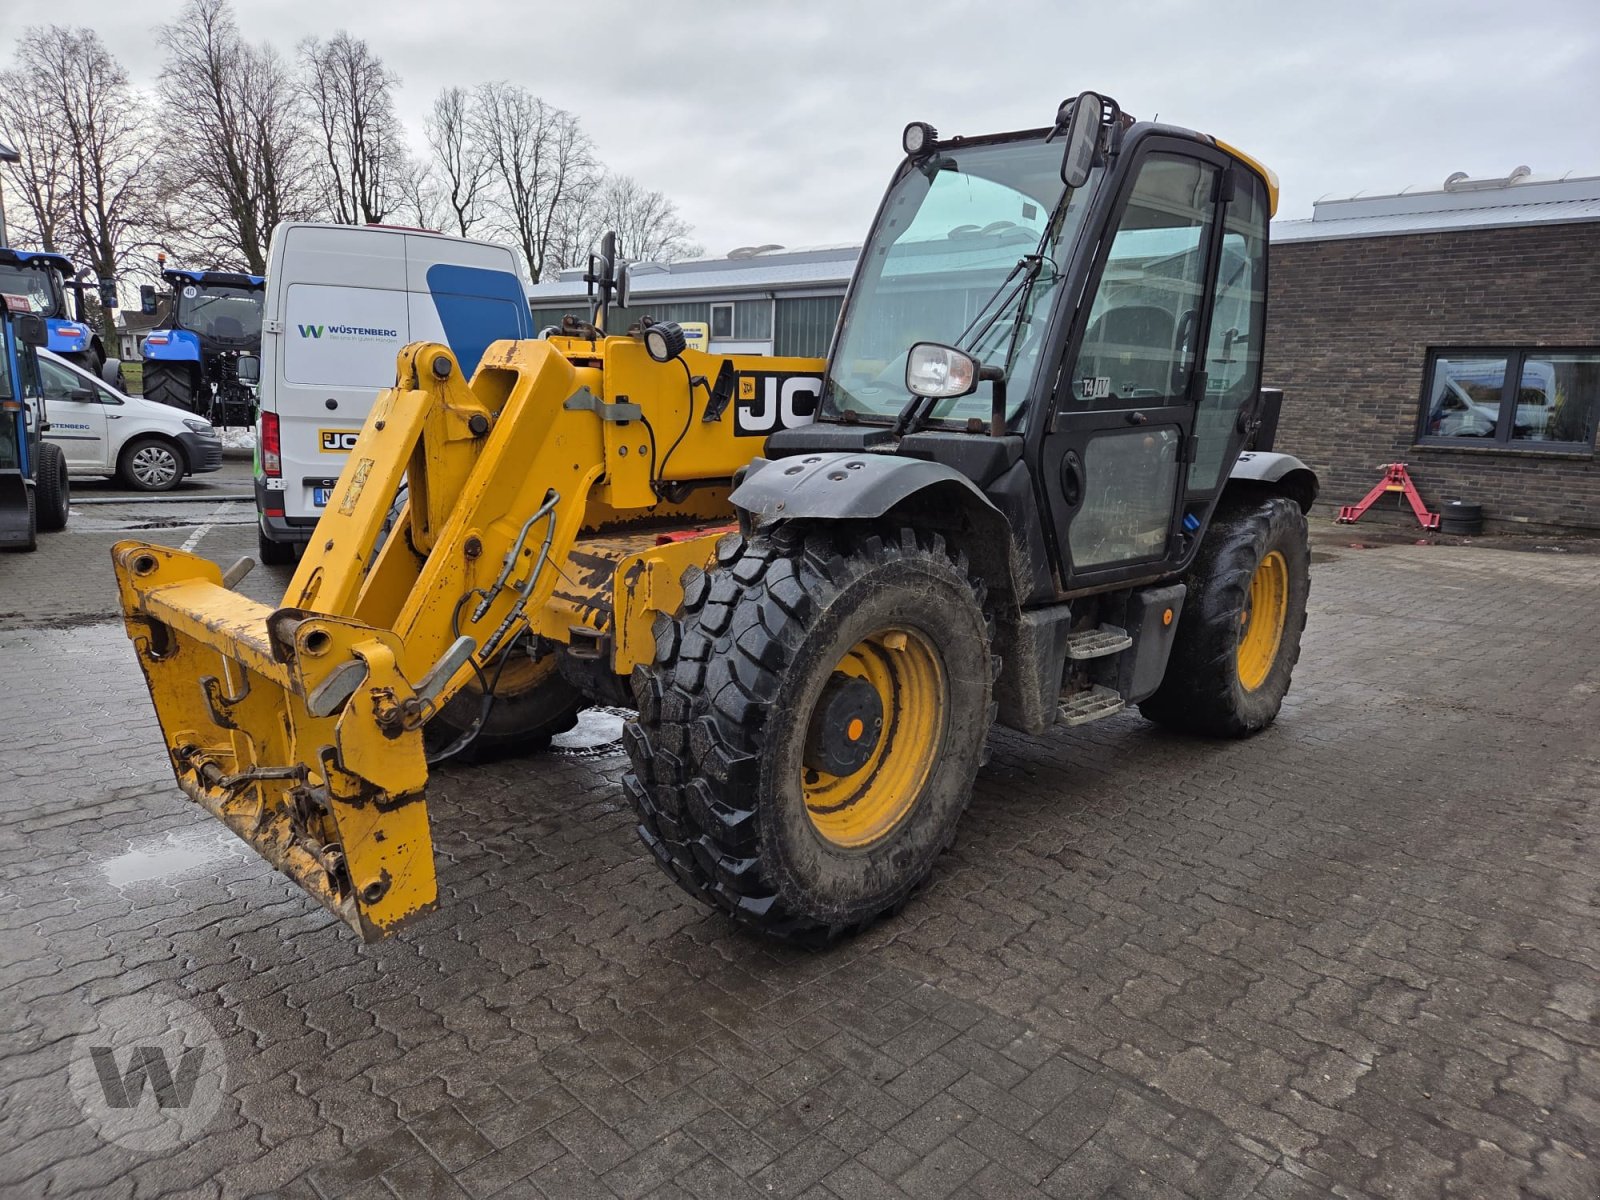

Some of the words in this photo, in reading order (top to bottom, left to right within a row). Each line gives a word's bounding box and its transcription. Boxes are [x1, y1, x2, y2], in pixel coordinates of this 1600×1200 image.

[186, 288, 194, 296] 40
[328, 325, 397, 336] WÜSTENBERG
[739, 377, 822, 430] JC
[324, 434, 359, 449] JC
